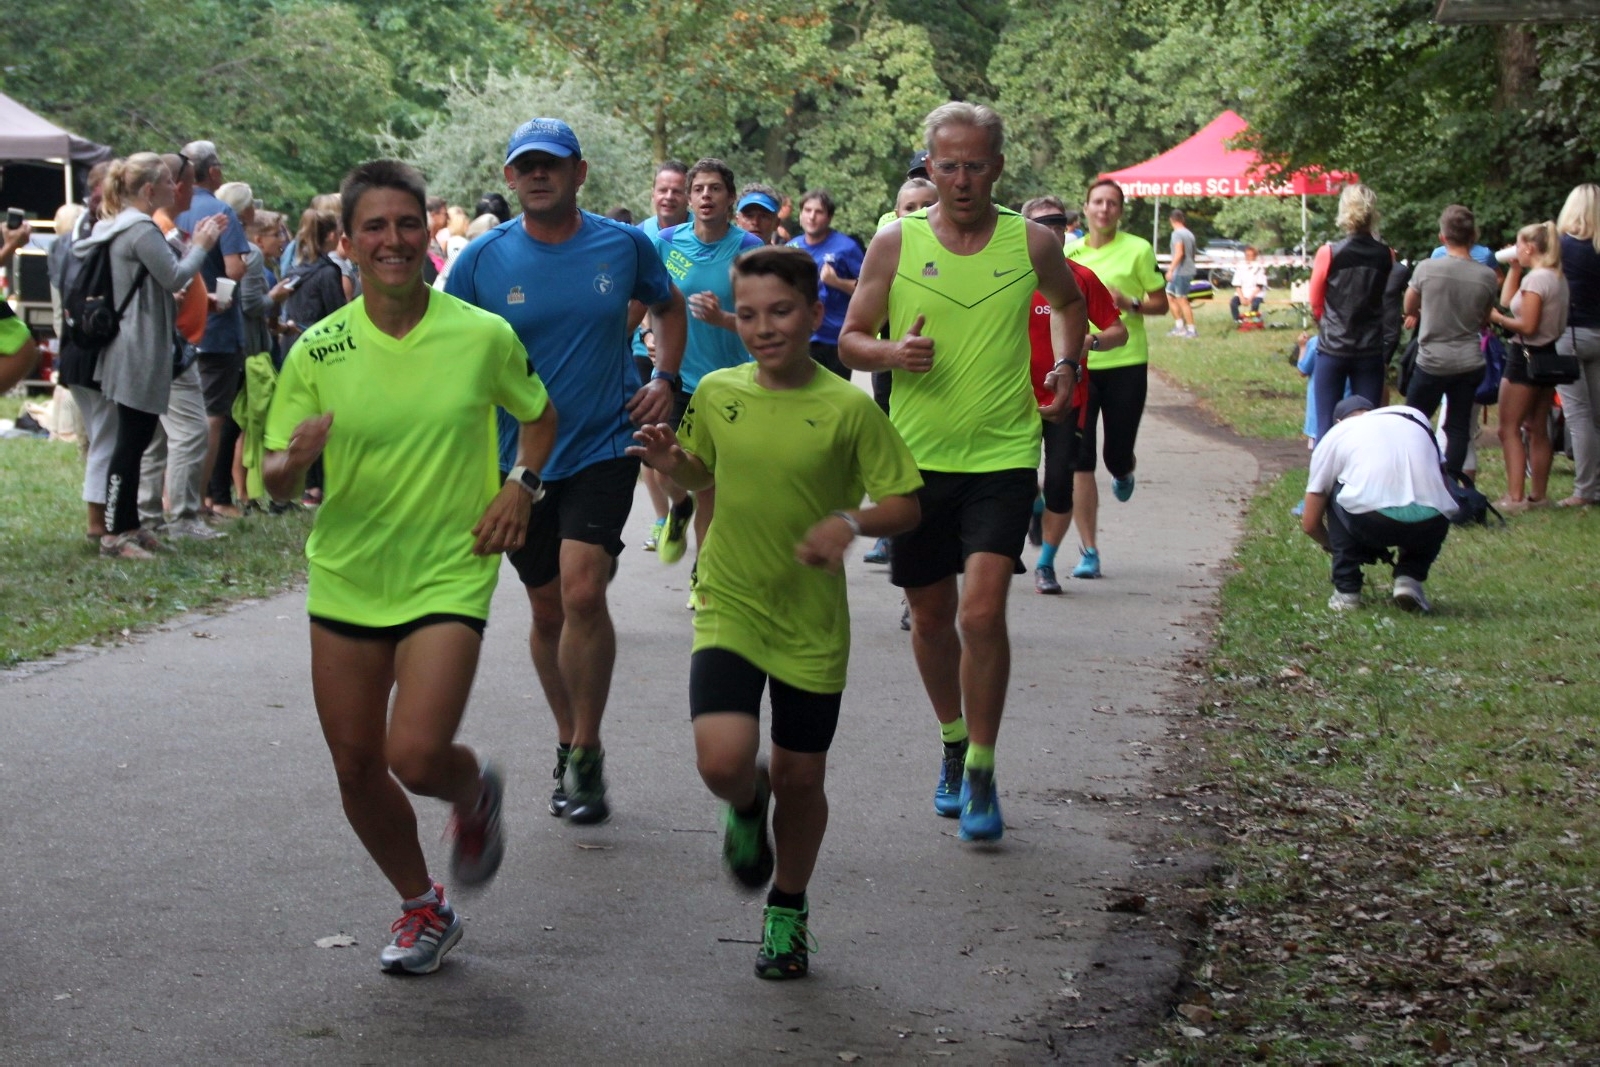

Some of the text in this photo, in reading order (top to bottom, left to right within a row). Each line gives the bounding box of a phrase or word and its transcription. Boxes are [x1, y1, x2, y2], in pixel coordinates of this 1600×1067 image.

[1116, 180, 1170, 195] artner
[1173, 178, 1202, 195] des
[1206, 178, 1230, 195] SC
[308, 335, 357, 364] sport
